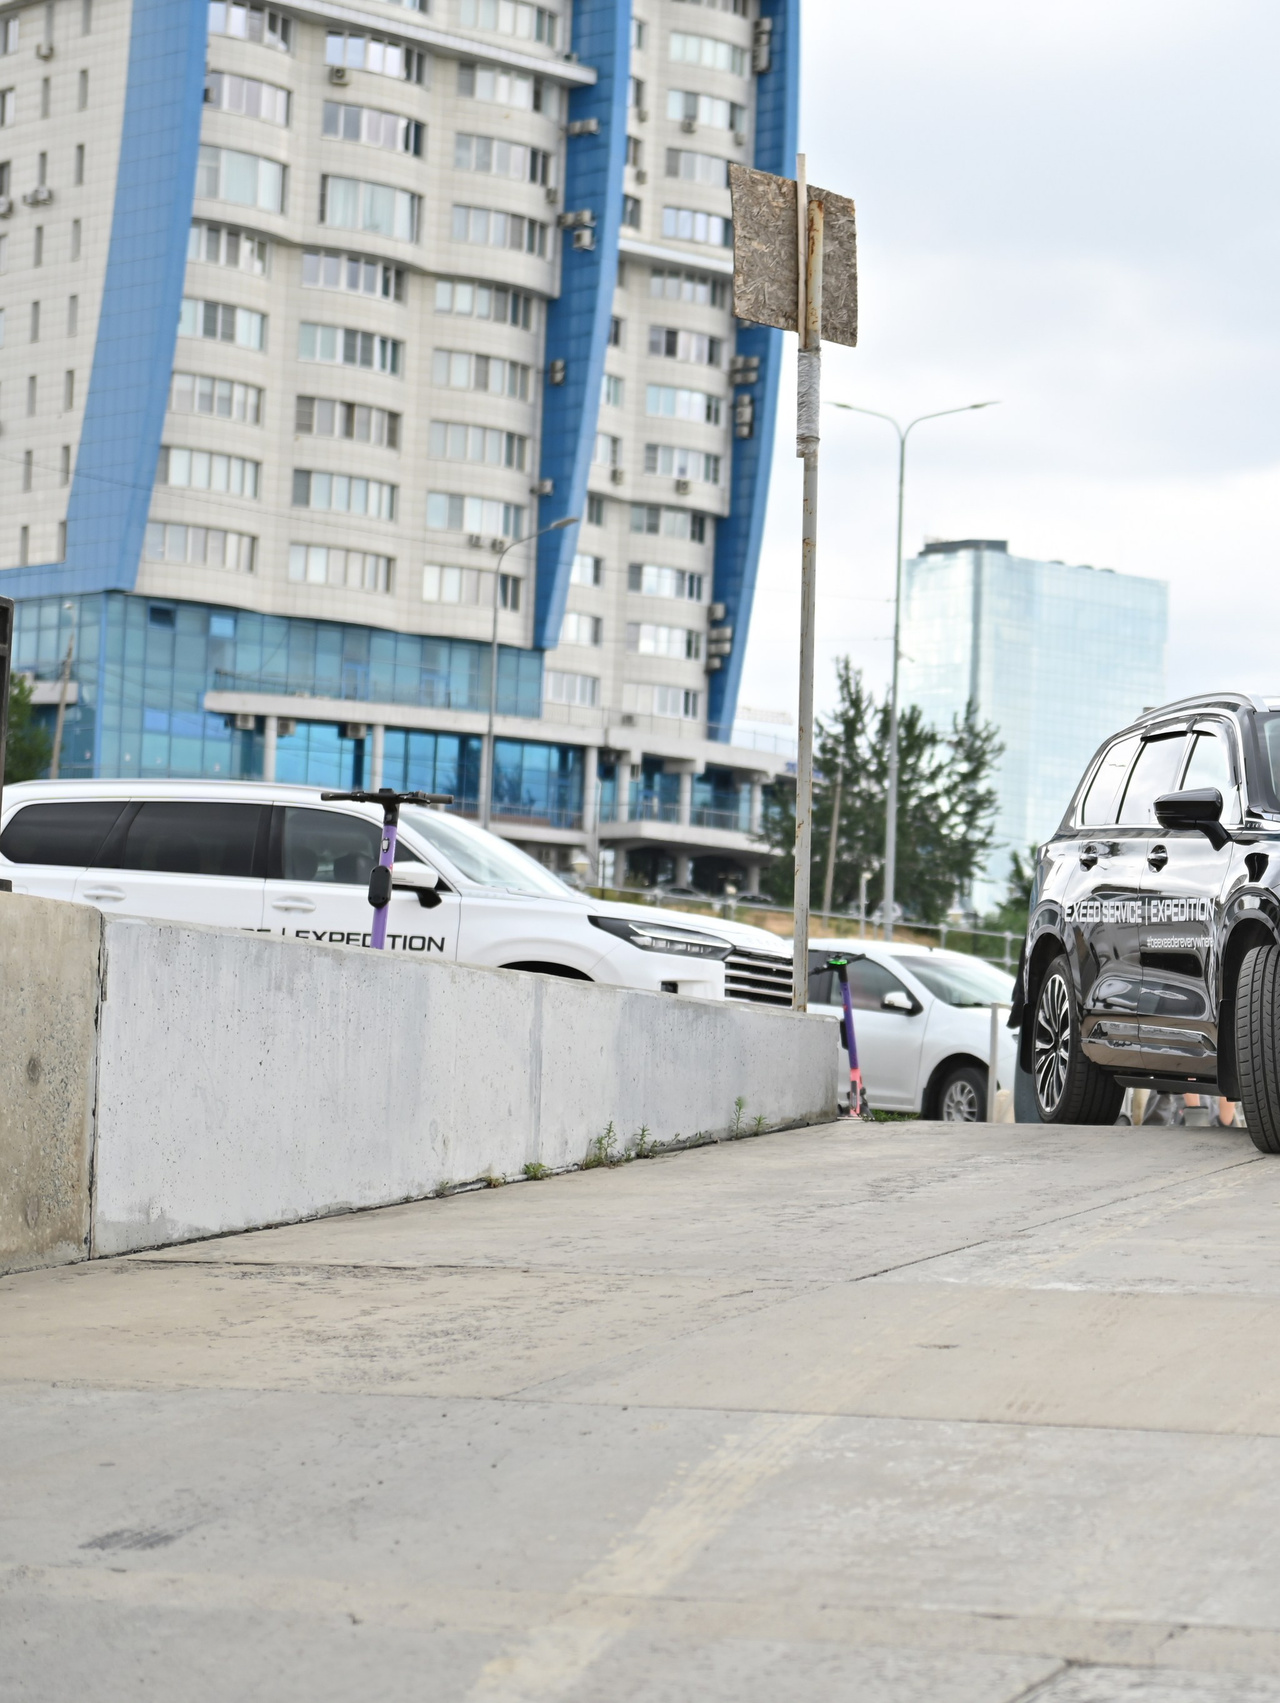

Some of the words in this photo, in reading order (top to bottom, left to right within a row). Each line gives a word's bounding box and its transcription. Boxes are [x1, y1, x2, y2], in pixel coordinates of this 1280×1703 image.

[1065, 901, 1101, 923] EXEED
[1102, 901, 1143, 923] SERVICE
[1151, 898, 1216, 922] EXPEDITION
[295, 930, 445, 952] EXPEDTION
